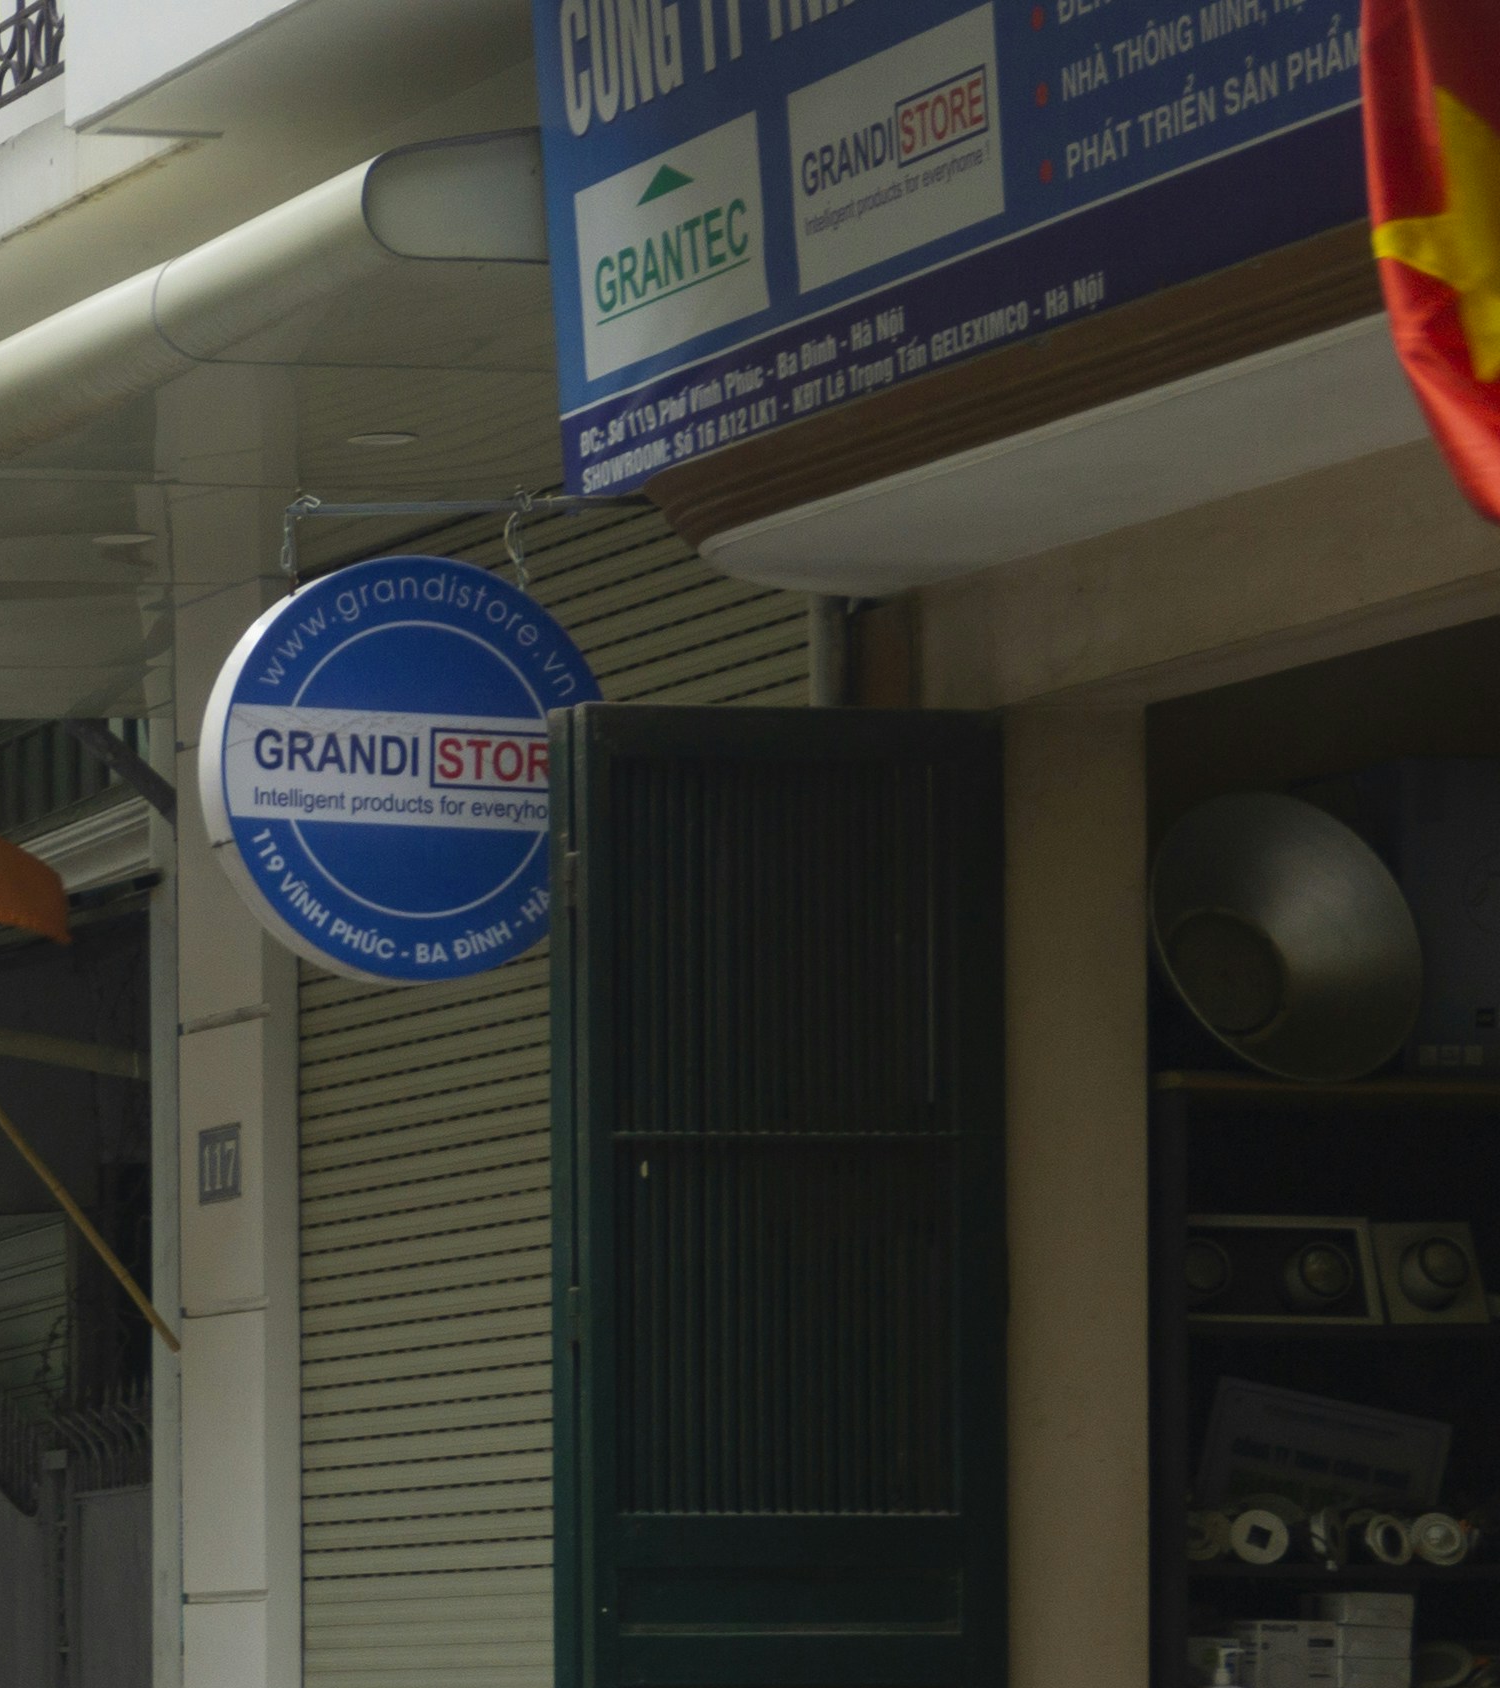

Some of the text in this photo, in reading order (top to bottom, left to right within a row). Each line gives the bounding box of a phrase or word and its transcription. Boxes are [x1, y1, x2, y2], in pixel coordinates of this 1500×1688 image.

[1061, 43, 1109, 101] NHÀ
[1112, 15, 1195, 79] THÔNG
[801, 77, 984, 197] GRANDI STORE
[1066, 117, 1131, 179] PHÁT
[1138, 74, 1217, 148] TRIỂN
[1222, 56, 1279, 116] SẢN
[595, 198, 750, 314] GRANTEC
[1045, 284, 1069, 320] Hà
[776, 351, 798, 380] Ba
[851, 319, 873, 351] Hà
[259, 573, 577, 697] www.grandistore.vn
[254, 728, 419, 777] GRANDI
[254, 786, 346, 814] Intelligent
[351, 793, 433, 817] products
[439, 795, 464, 816] for
[251, 827, 285, 871] 119
[280, 871, 326, 929] VĨNH
[329, 919, 395, 961] PHÚC
[415, 942, 449, 964] BA
[452, 917, 514, 961] ĐÌNH
